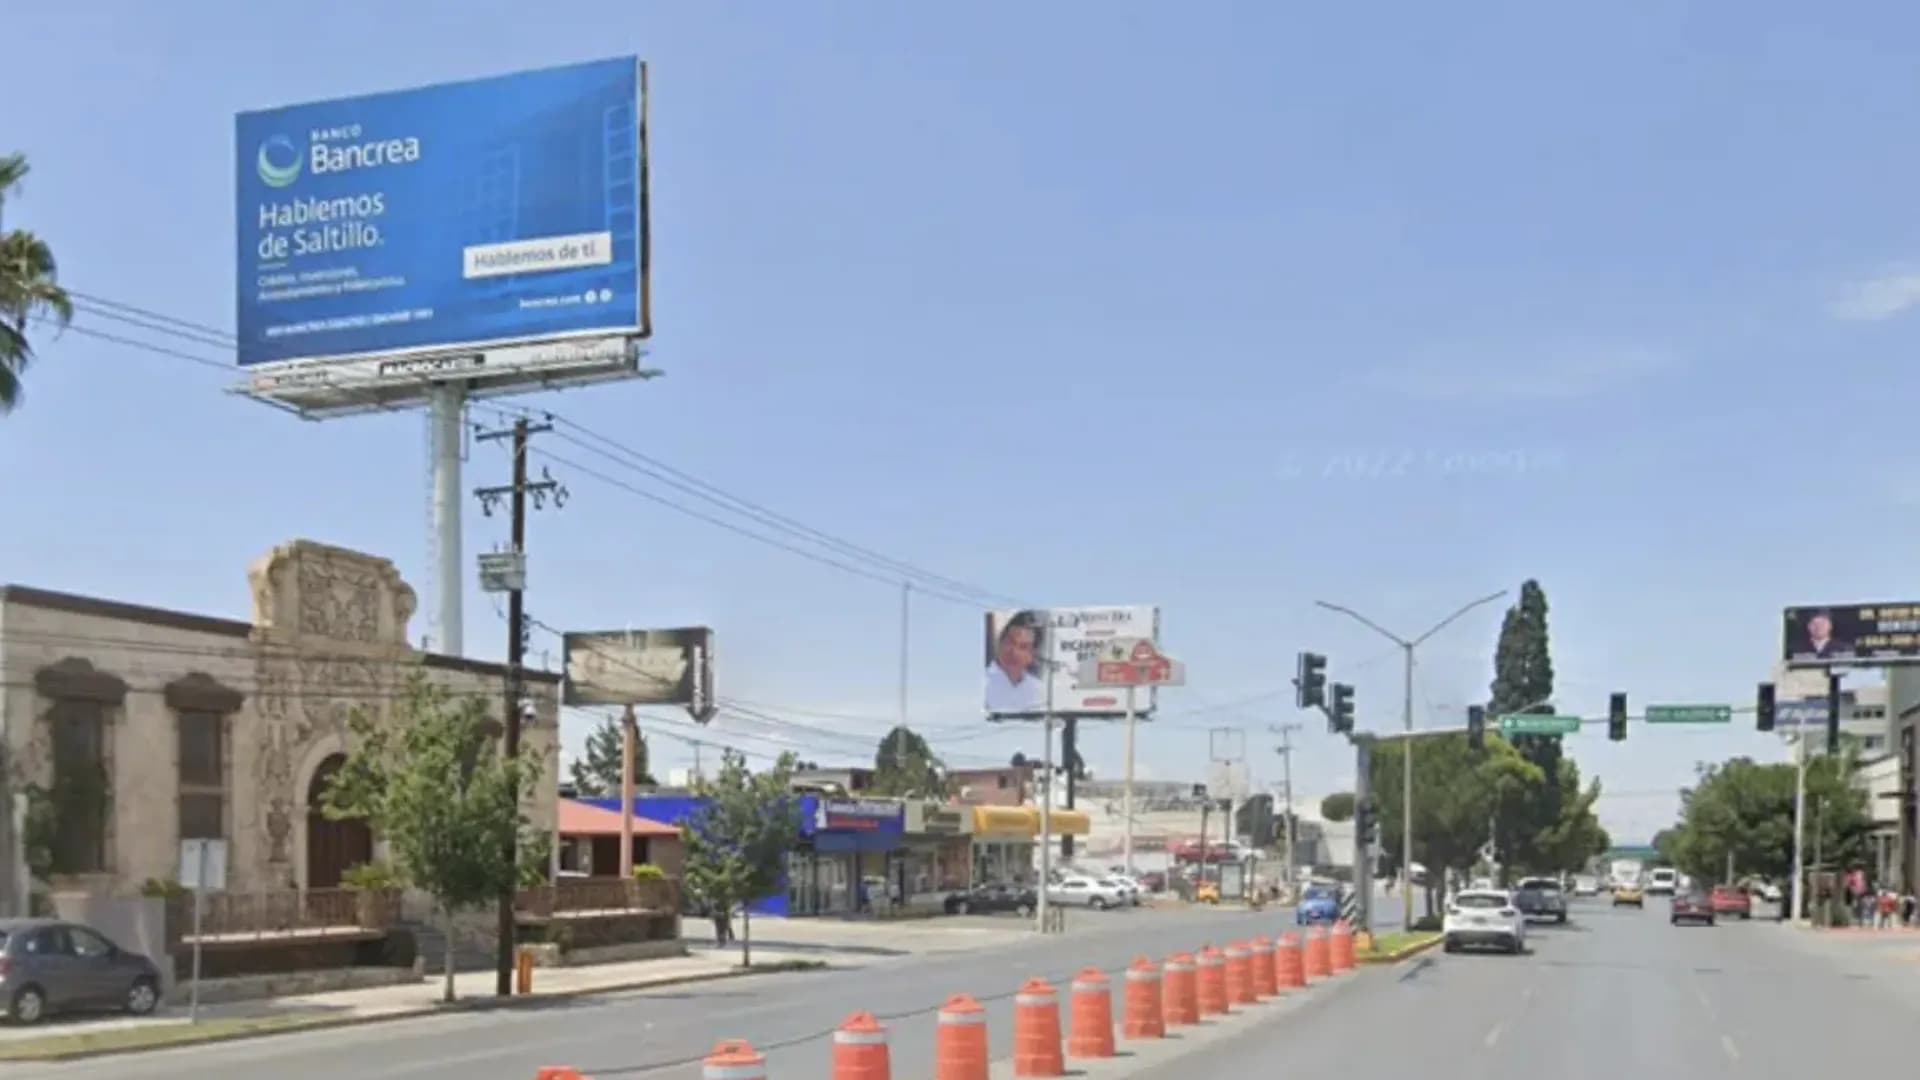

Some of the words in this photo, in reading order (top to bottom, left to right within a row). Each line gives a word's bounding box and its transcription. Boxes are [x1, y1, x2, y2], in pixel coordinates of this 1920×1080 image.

[311, 124, 362, 141] BANCO
[311, 137, 420, 174] Bancrea
[258, 192, 385, 229] Hablemos
[258, 232, 288, 260] de
[293, 220, 385, 256] Saltillo.
[474, 249, 555, 268] Hablemos
[559, 244, 578, 260] de
